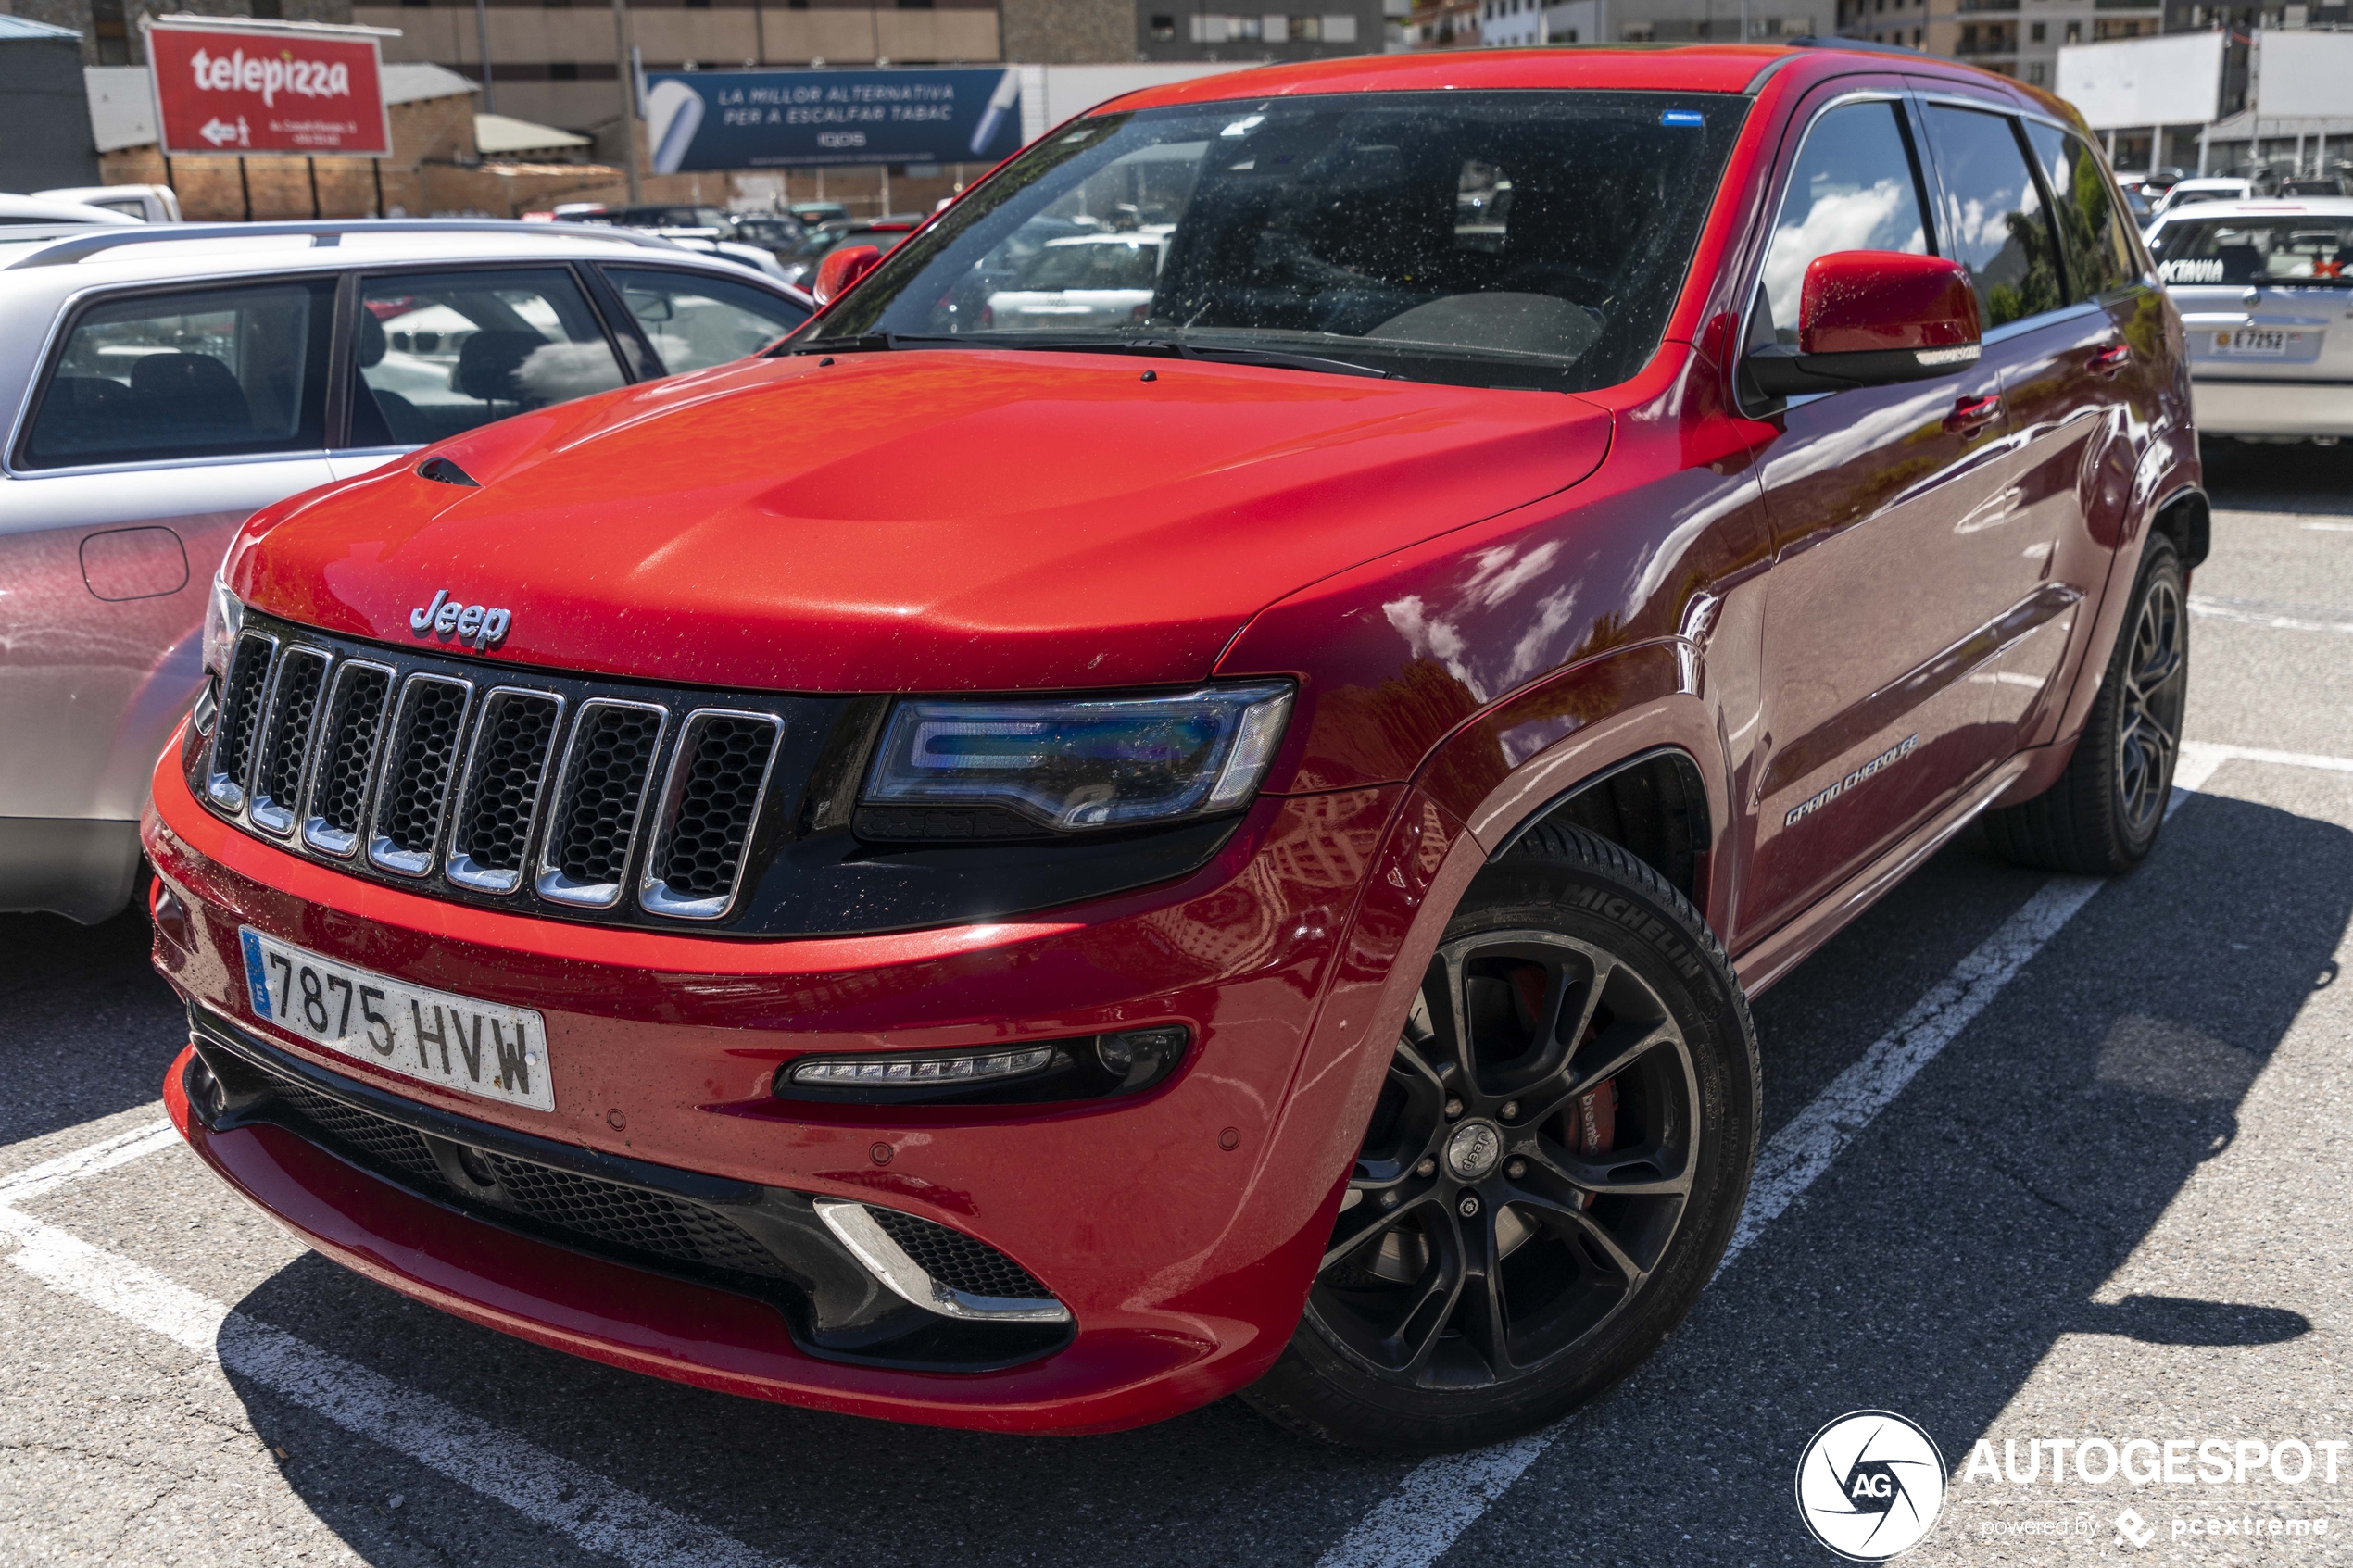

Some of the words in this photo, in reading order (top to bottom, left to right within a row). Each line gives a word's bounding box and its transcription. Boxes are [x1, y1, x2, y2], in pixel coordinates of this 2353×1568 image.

[190, 47, 350, 108] telepizza
[717, 87, 744, 106] LA
[749, 85, 823, 105] MILLOR
[825, 83, 955, 103] ALTERNATIVA
[724, 107, 762, 126] PER
[766, 107, 782, 125] A
[786, 104, 886, 125] ESCALFAR
[890, 104, 954, 122] TABAC
[816, 131, 867, 148] IQOS
[2157, 259, 2224, 283] OCTAVIA
[409, 589, 511, 651] Jeep
[1783, 781, 1842, 828] GRAND
[1842, 732, 1919, 792] CHEROKEE
[1559, 882, 1706, 980] MICHELIN
[255, 983, 266, 1003] E
[269, 952, 396, 1057] 7875
[411, 999, 530, 1095] HVW
[1461, 1131, 1490, 1172] Jeep
[1581, 1093, 1600, 1157] brembo
